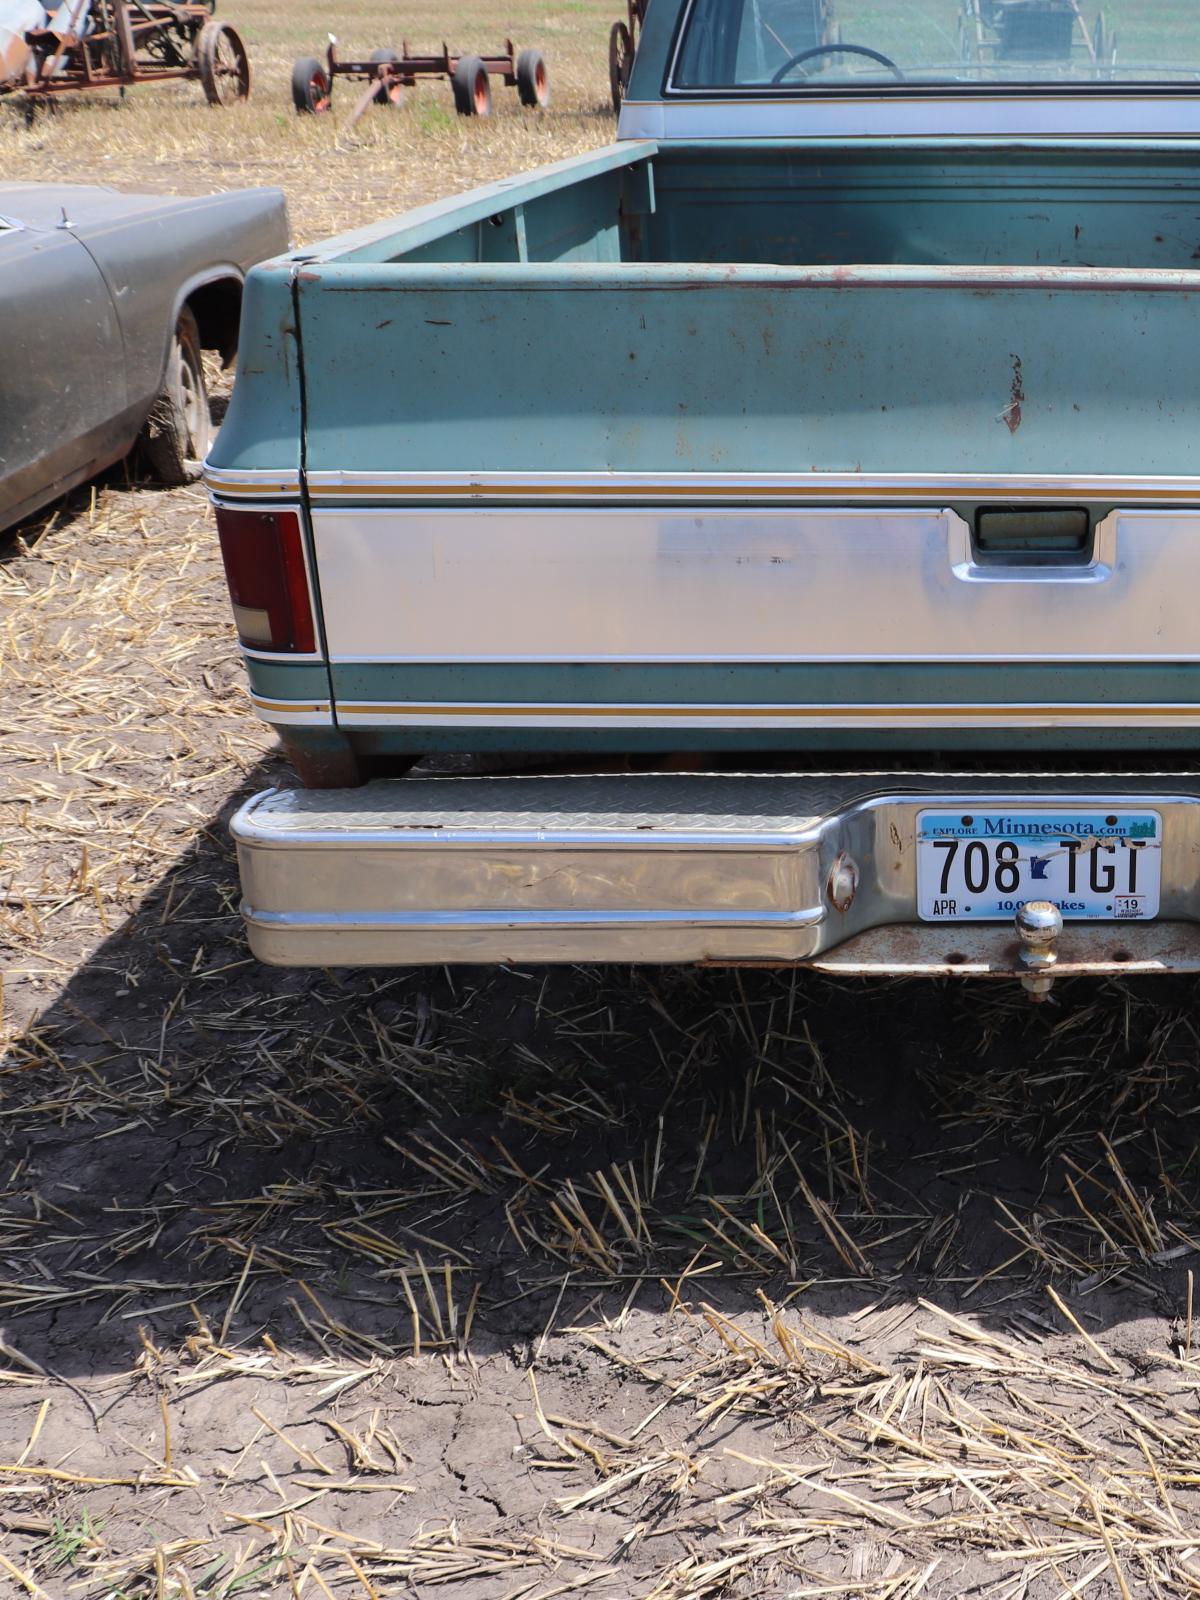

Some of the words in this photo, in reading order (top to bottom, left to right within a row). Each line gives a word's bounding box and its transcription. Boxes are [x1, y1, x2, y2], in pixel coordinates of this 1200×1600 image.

[932, 827, 978, 835] EXPLORE
[933, 840, 1020, 894] 708
[1060, 841, 1146, 894] TGT
[933, 899, 957, 916] APR
[1123, 899, 1139, 910] 19
